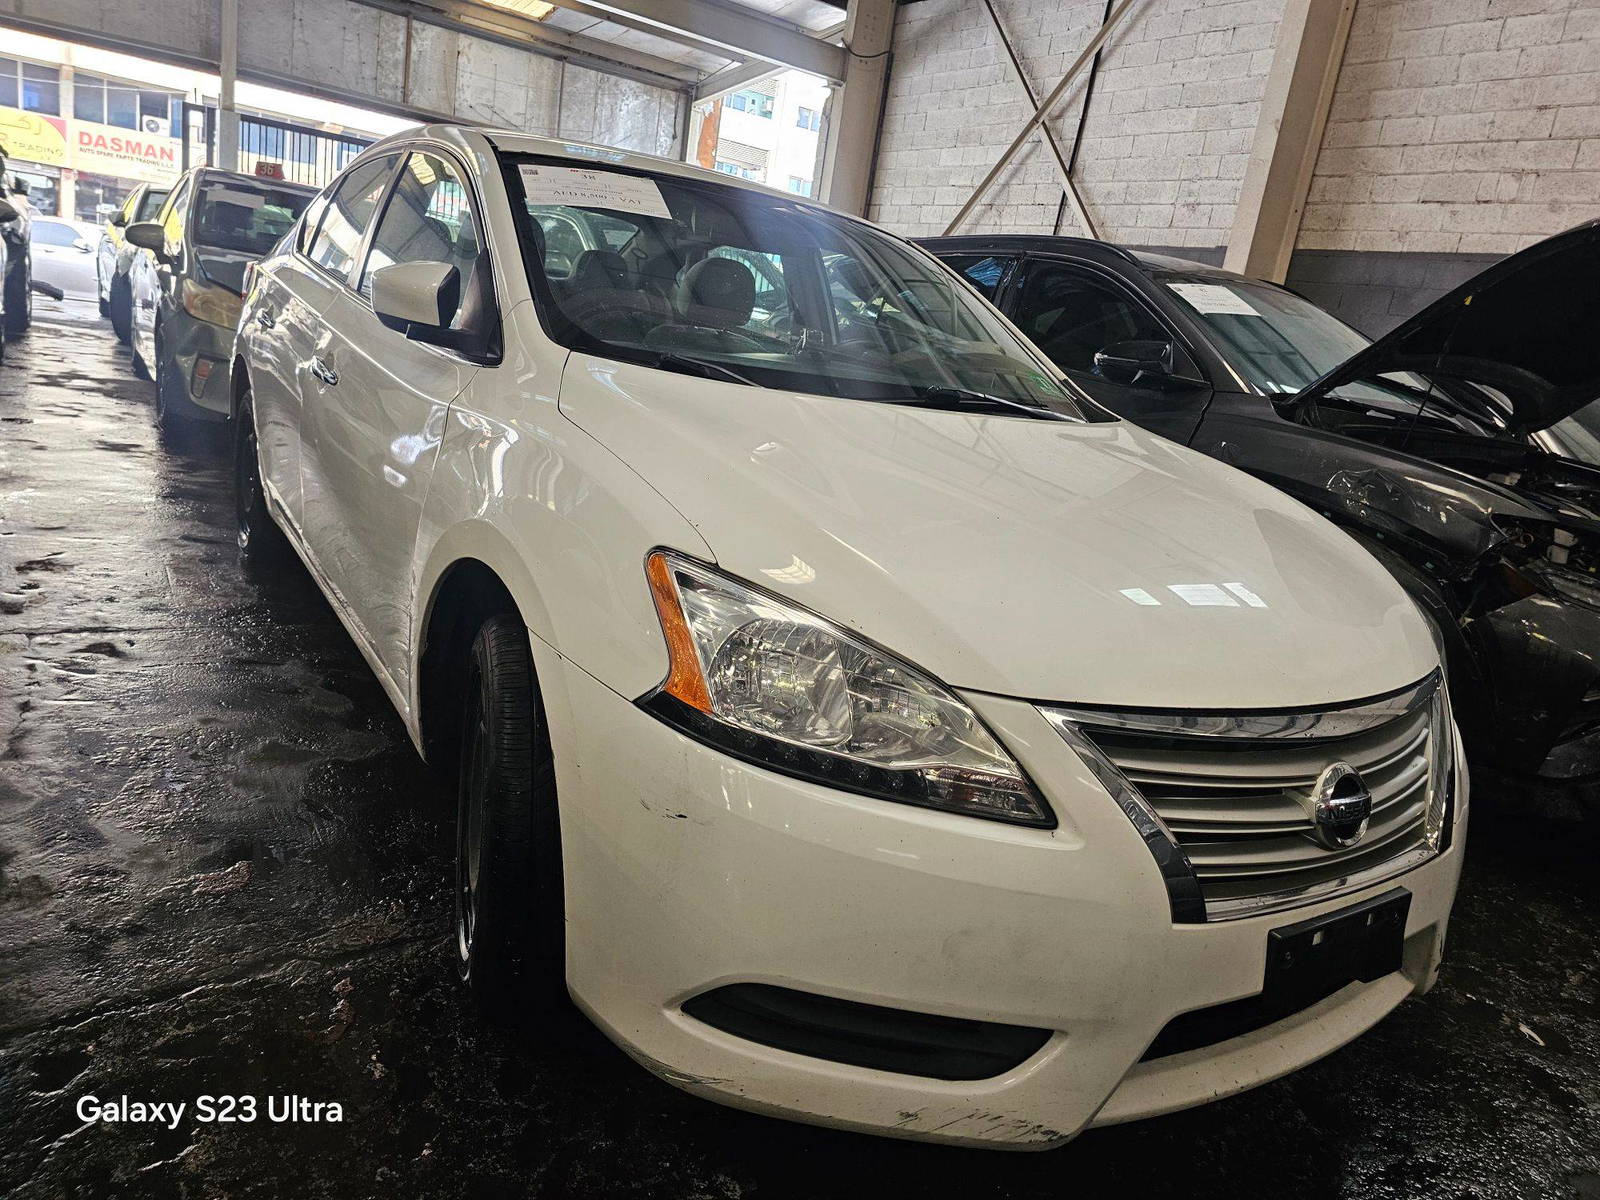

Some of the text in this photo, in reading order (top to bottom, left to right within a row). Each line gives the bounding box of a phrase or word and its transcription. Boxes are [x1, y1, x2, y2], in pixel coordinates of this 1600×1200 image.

[13, 141, 64, 157] TRADING
[79, 131, 174, 161] DASMAN
[79, 147, 95, 155] AUTO
[96, 150, 114, 158] SPARE
[116, 153, 135, 162] PARTS
[136, 157, 160, 167] TRADING
[260, 163, 274, 176] 36
